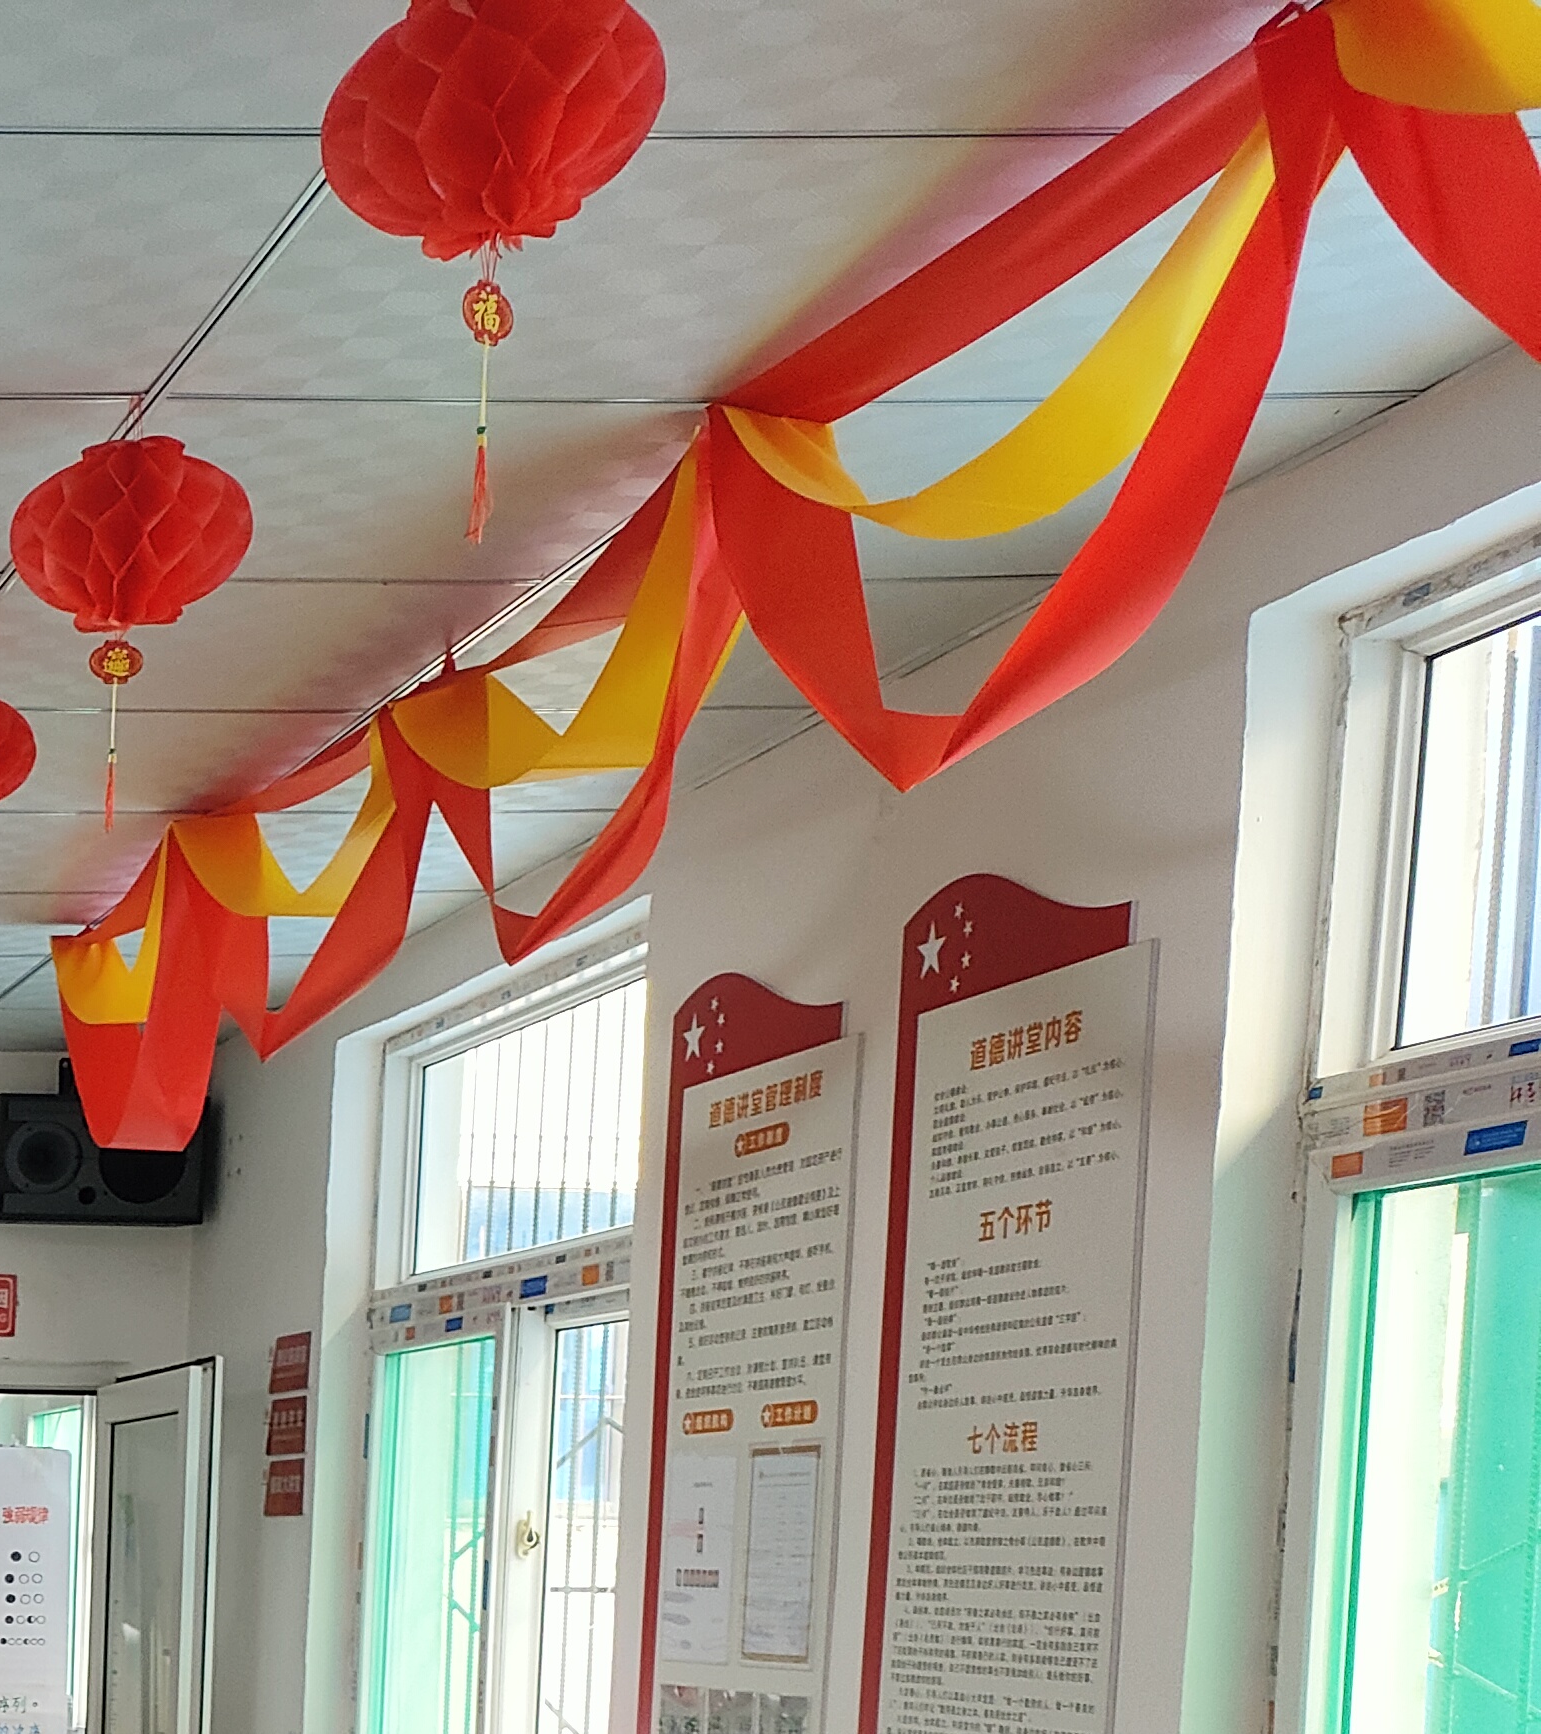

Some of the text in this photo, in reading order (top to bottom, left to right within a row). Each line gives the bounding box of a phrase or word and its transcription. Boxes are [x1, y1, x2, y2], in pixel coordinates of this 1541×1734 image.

[472, 290, 501, 334] 福
[970, 1010, 1083, 1071] 道德讲堂内容
[978, 1199, 1053, 1242] 五个环节
[967, 1421, 1038, 1454] 七个流程
